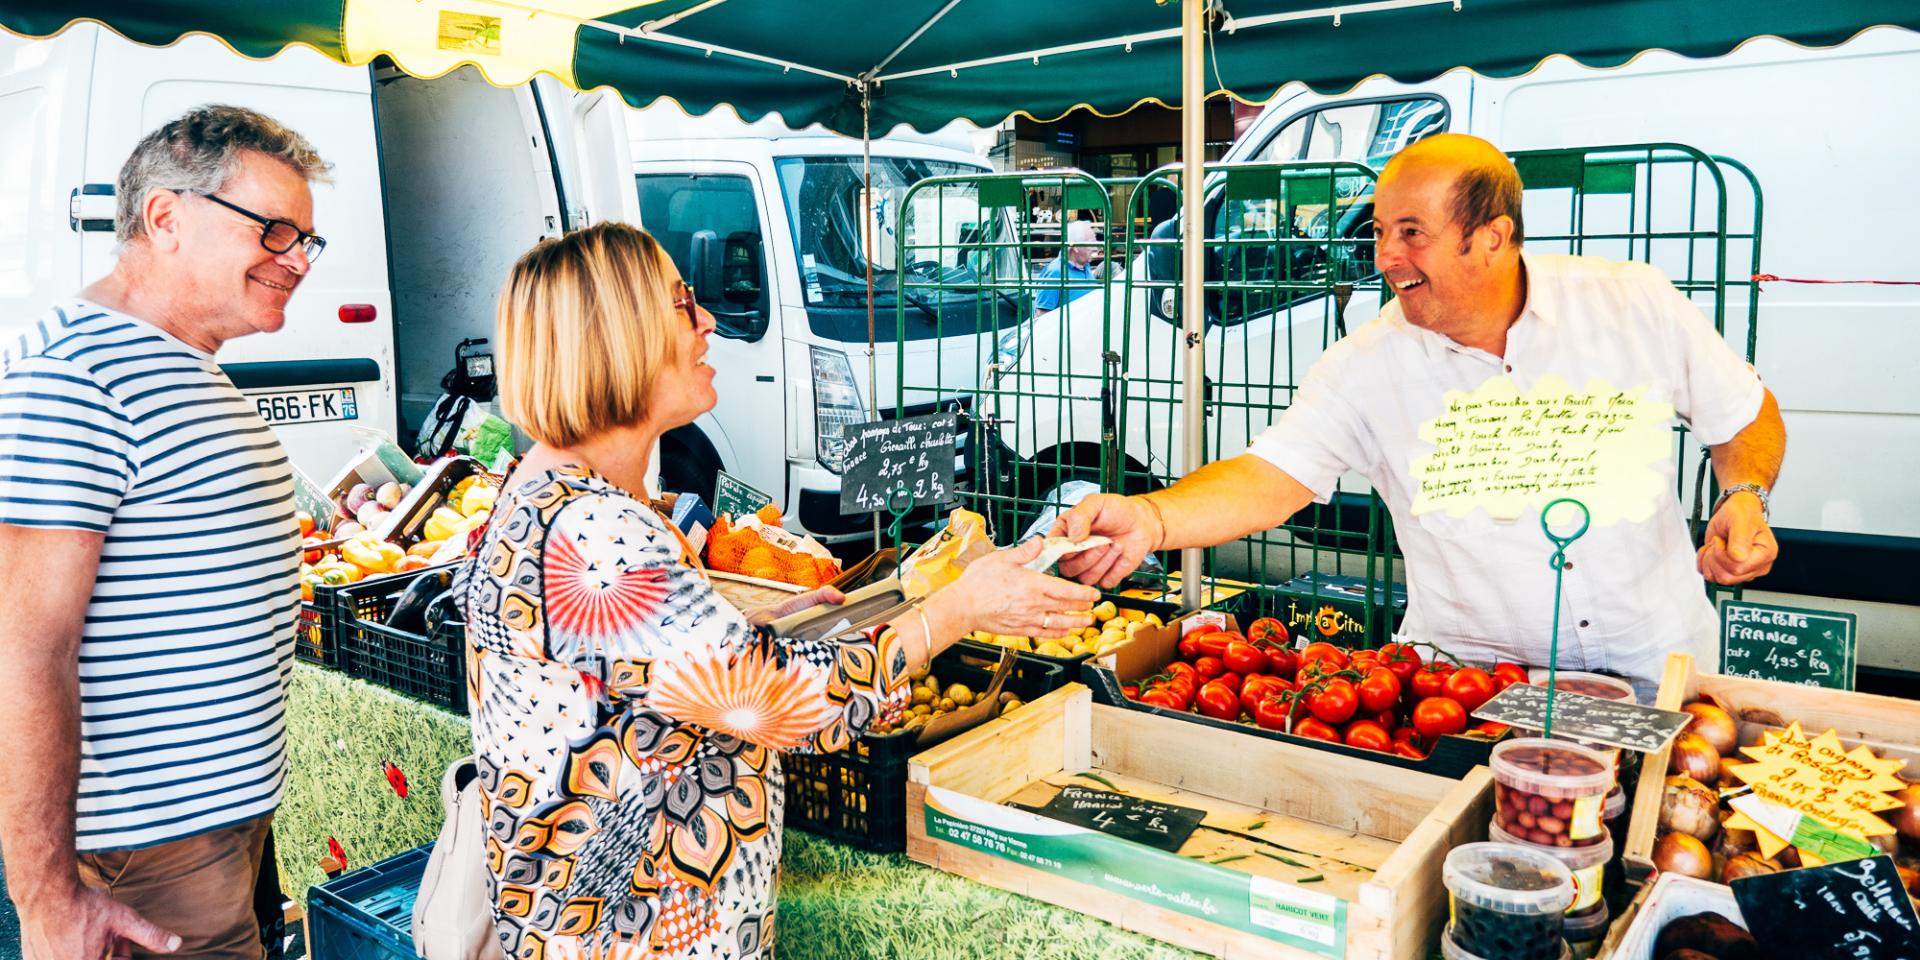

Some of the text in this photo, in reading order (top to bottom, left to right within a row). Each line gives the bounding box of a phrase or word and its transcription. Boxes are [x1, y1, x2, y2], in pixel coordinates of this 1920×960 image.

[257, 393, 338, 421] 666-FK
[342, 404, 355, 416] 76
[878, 458, 906, 478] 2,75
[856, 483, 885, 509] 4,50
[913, 479, 928, 498] 2
[1333, 611, 1366, 634] Citru
[1764, 647, 1799, 670] 4,95
[1092, 811, 1116, 829] 4
[948, 828, 960, 839] 02
[960, 831, 971, 842] 47
[1275, 902, 1308, 917] HARICOT
[1310, 909, 1329, 922] VERT
